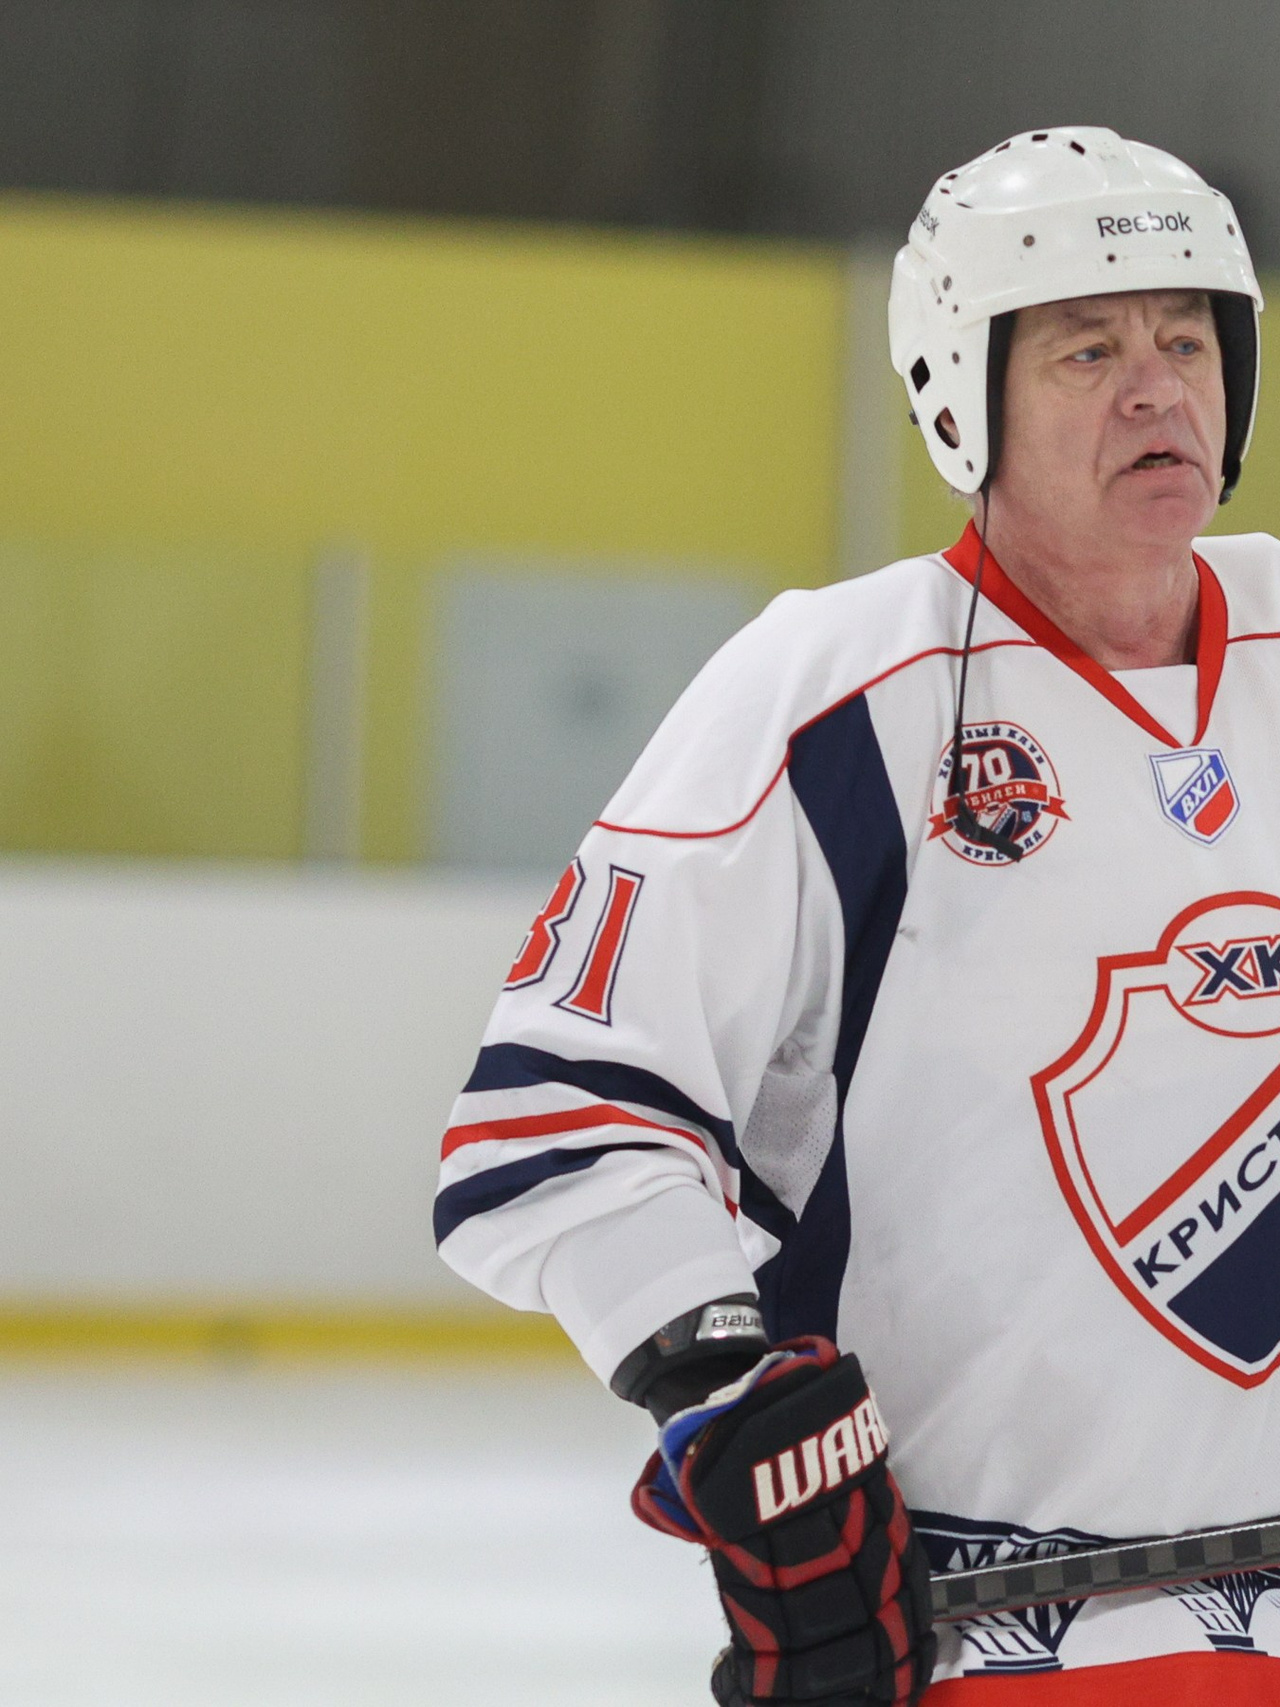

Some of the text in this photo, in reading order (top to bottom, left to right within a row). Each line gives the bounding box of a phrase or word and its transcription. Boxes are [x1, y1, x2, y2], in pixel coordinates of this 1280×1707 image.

[1096, 210, 1193, 238] Reebok
[961, 747, 1012, 793] 70
[964, 784, 1027, 807] БИЛЕЙ
[1180, 766, 1219, 818] ВХЛ
